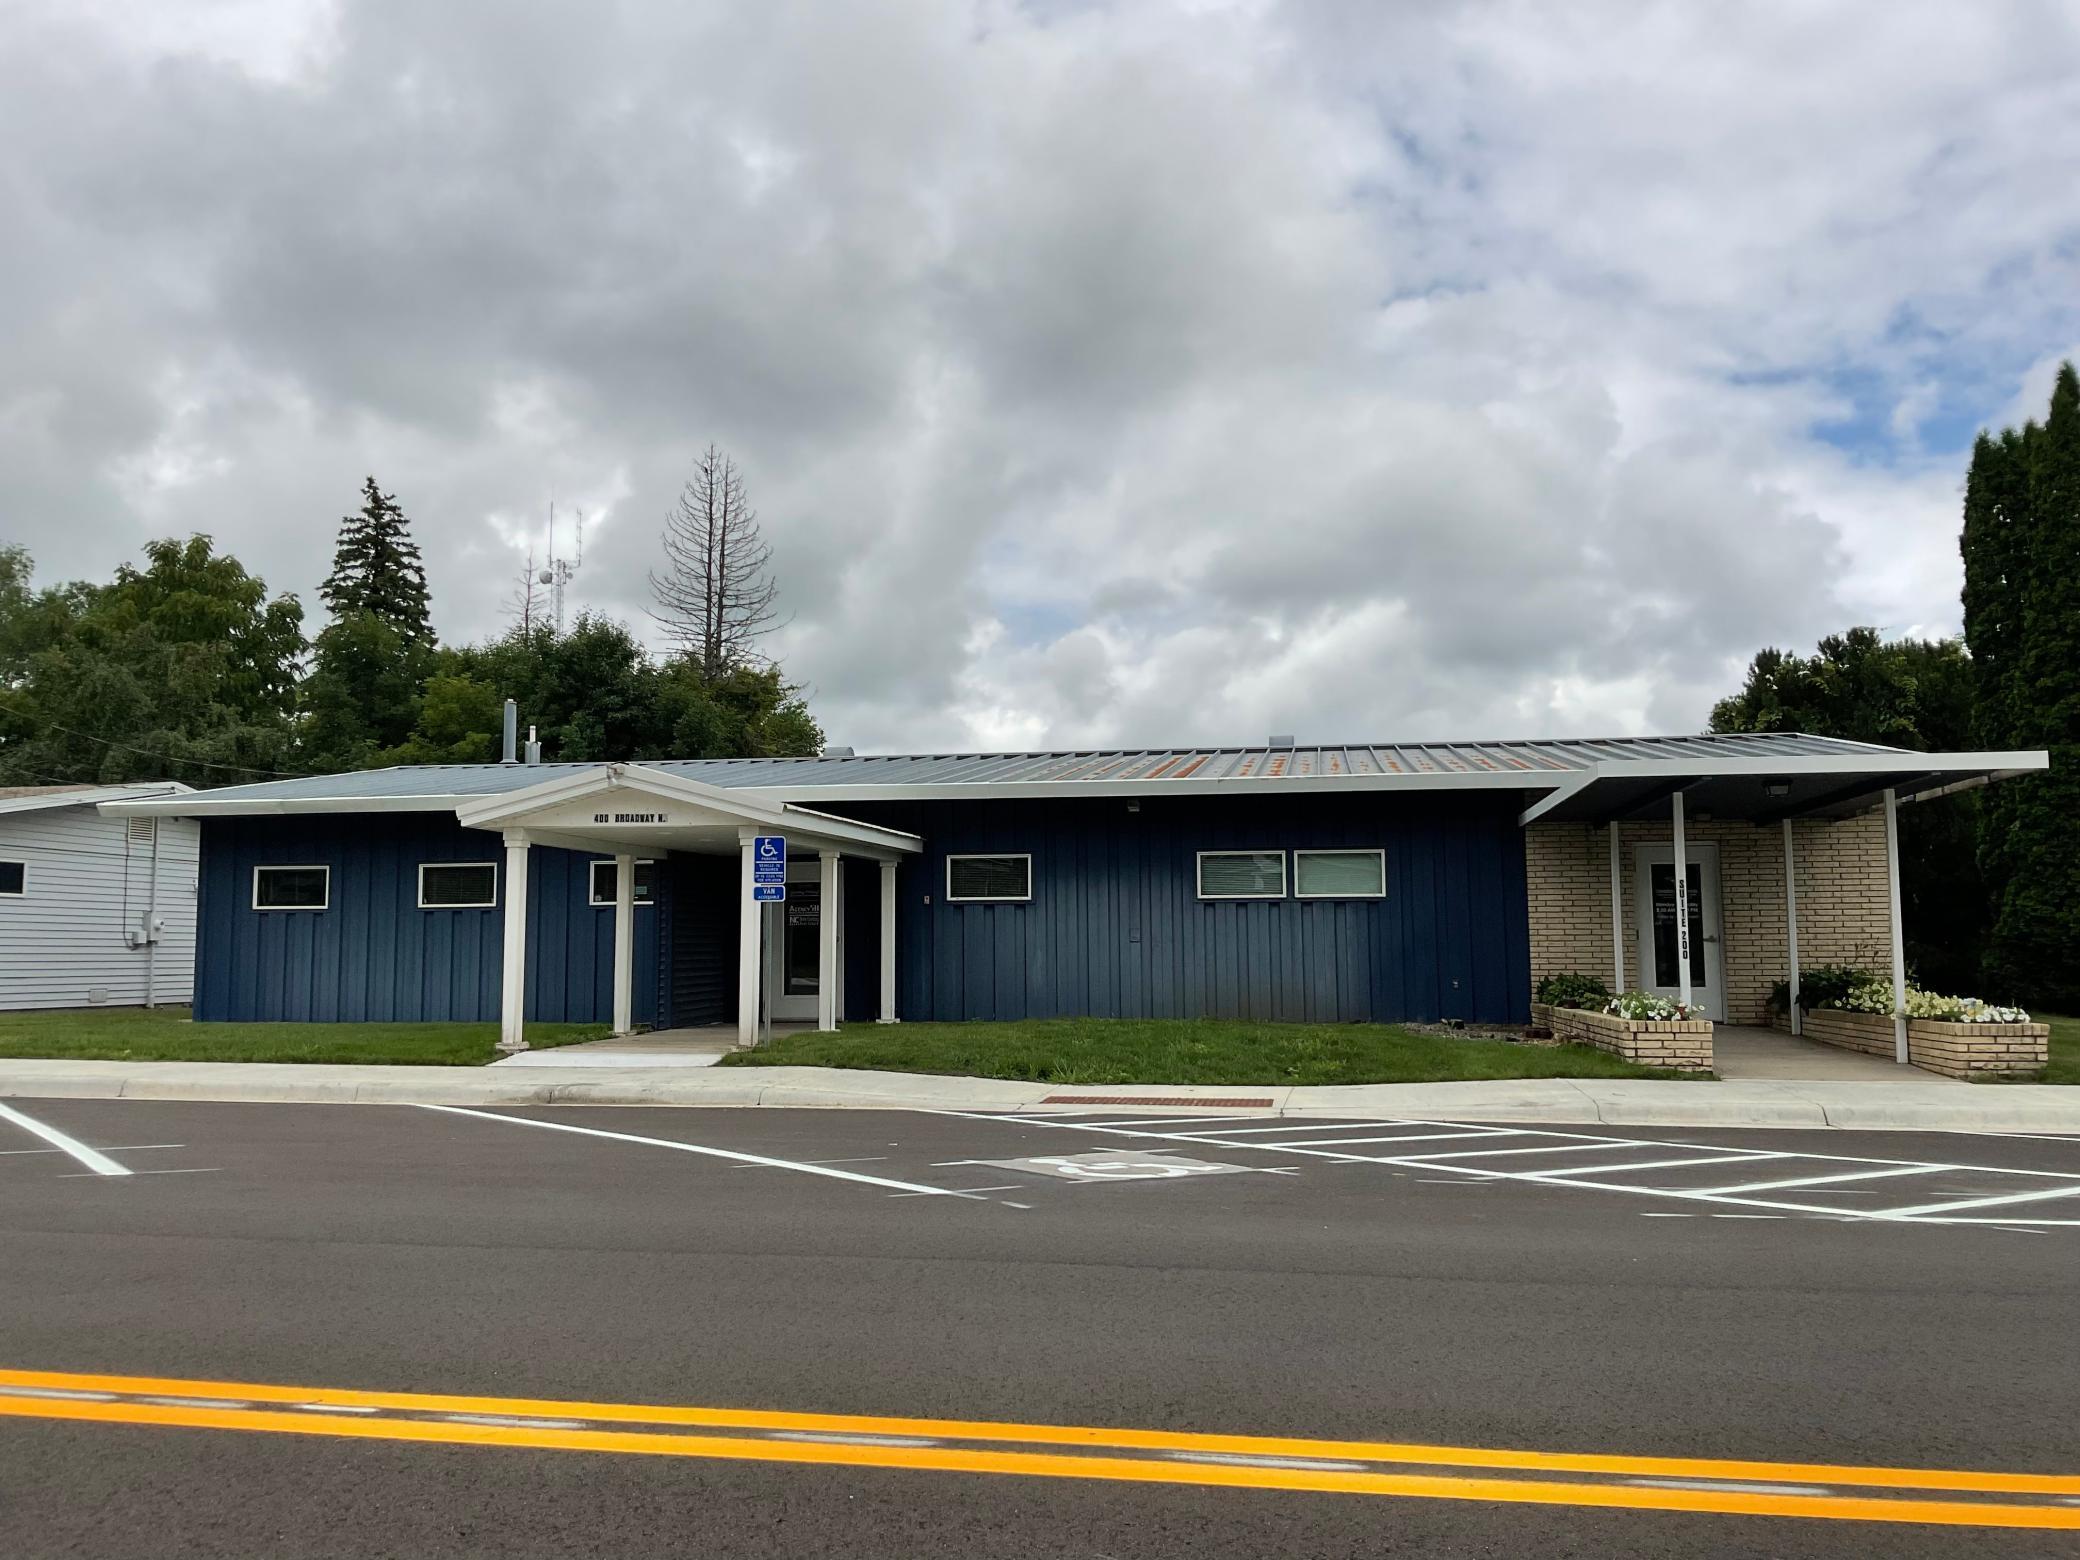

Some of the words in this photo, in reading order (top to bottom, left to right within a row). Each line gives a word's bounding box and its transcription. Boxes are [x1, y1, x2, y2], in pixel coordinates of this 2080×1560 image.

[594, 813, 609, 823] 400
[615, 813, 655, 823] BROADWAY
[762, 887, 776, 895] VAN
[1679, 879, 1687, 928] SUITE
[1681, 930, 1689, 960] 200
